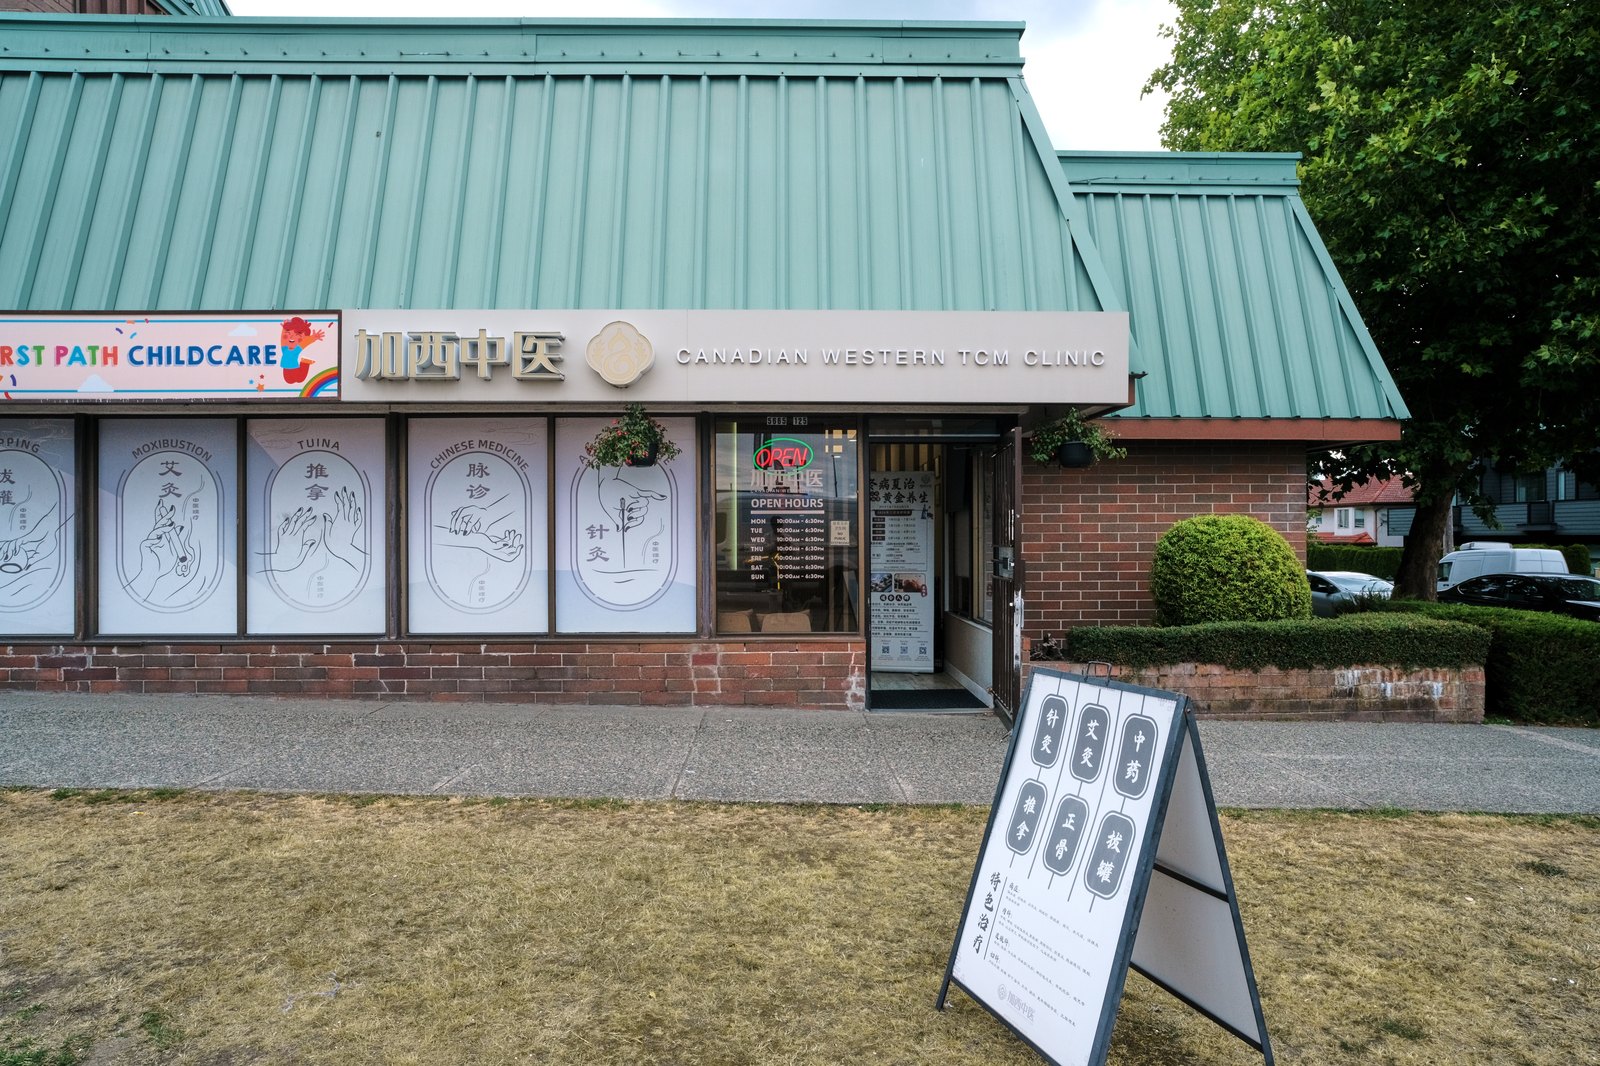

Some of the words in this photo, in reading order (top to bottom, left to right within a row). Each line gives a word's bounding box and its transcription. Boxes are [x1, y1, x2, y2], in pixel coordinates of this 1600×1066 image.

[55, 345, 118, 366] PATH
[128, 345, 277, 366] CHILDCARE
[354, 329, 566, 381] 加西中医
[677, 347, 808, 366] CANADIAN
[822, 349, 946, 366] WESTERN
[957, 350, 1010, 367] TCM
[1024, 350, 1106, 368] CLINIC
[132, 439, 212, 461] MOXIBUSTION
[297, 438, 340, 450] TUINA
[430, 440, 475, 470] CHINESE
[478, 440, 530, 472] MEDICINE
[756, 448, 808, 467] OPEN
[158, 461, 182, 498] 艾灸
[305, 463, 329, 500] 推拿
[466, 463, 490, 500] 脉诊
[751, 499, 781, 508] OPEN
[785, 499, 824, 508] HOURS
[585, 524, 610, 562] 针灸
[1040, 708, 1059, 754] 针灸
[1080, 719, 1099, 768] 艾灸
[1125, 730, 1146, 784] 中药
[1016, 795, 1037, 841] 推拿
[1055, 813, 1075, 860] 正骨
[1097, 830, 1123, 884] 拔罐
[972, 871, 1001, 954] 特色治疗
